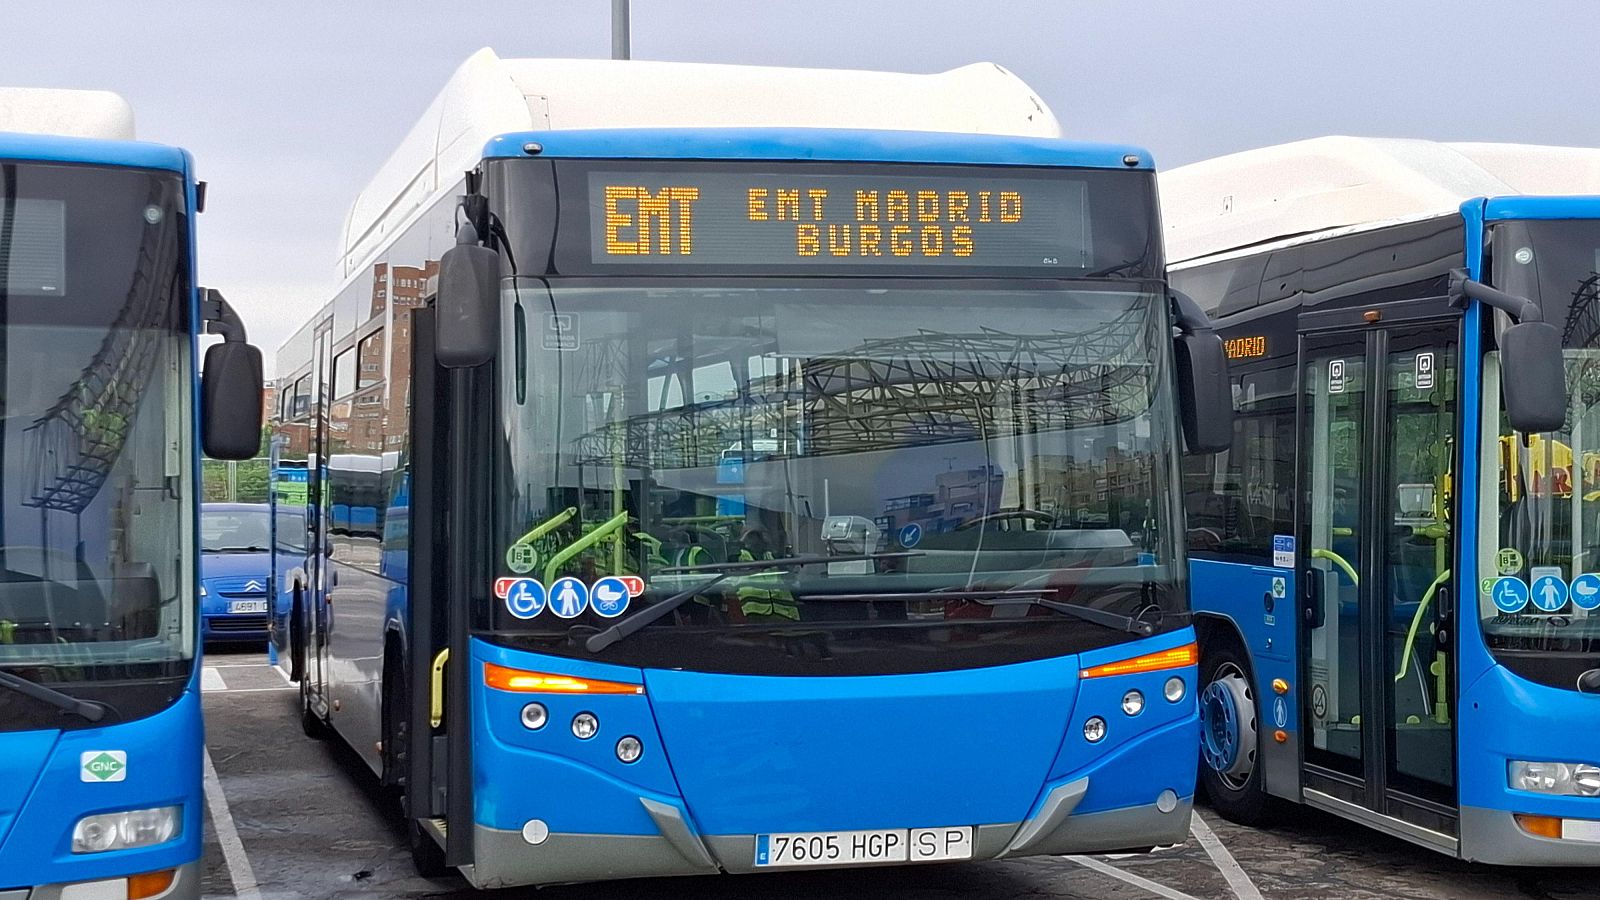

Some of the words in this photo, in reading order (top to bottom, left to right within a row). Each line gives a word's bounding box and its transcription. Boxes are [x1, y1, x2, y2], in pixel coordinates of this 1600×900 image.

[749, 188, 828, 221] EMT
[856, 190, 1021, 222] MADRID
[606, 186, 699, 254] EMT
[798, 224, 974, 256] BURGOS
[499, 580, 506, 593] 1
[629, 579, 637, 591] 1
[1484, 581, 1491, 591] 2
[91, 761, 117, 771] GNC
[776, 836, 839, 861] 7605
[852, 833, 899, 858] HGP
